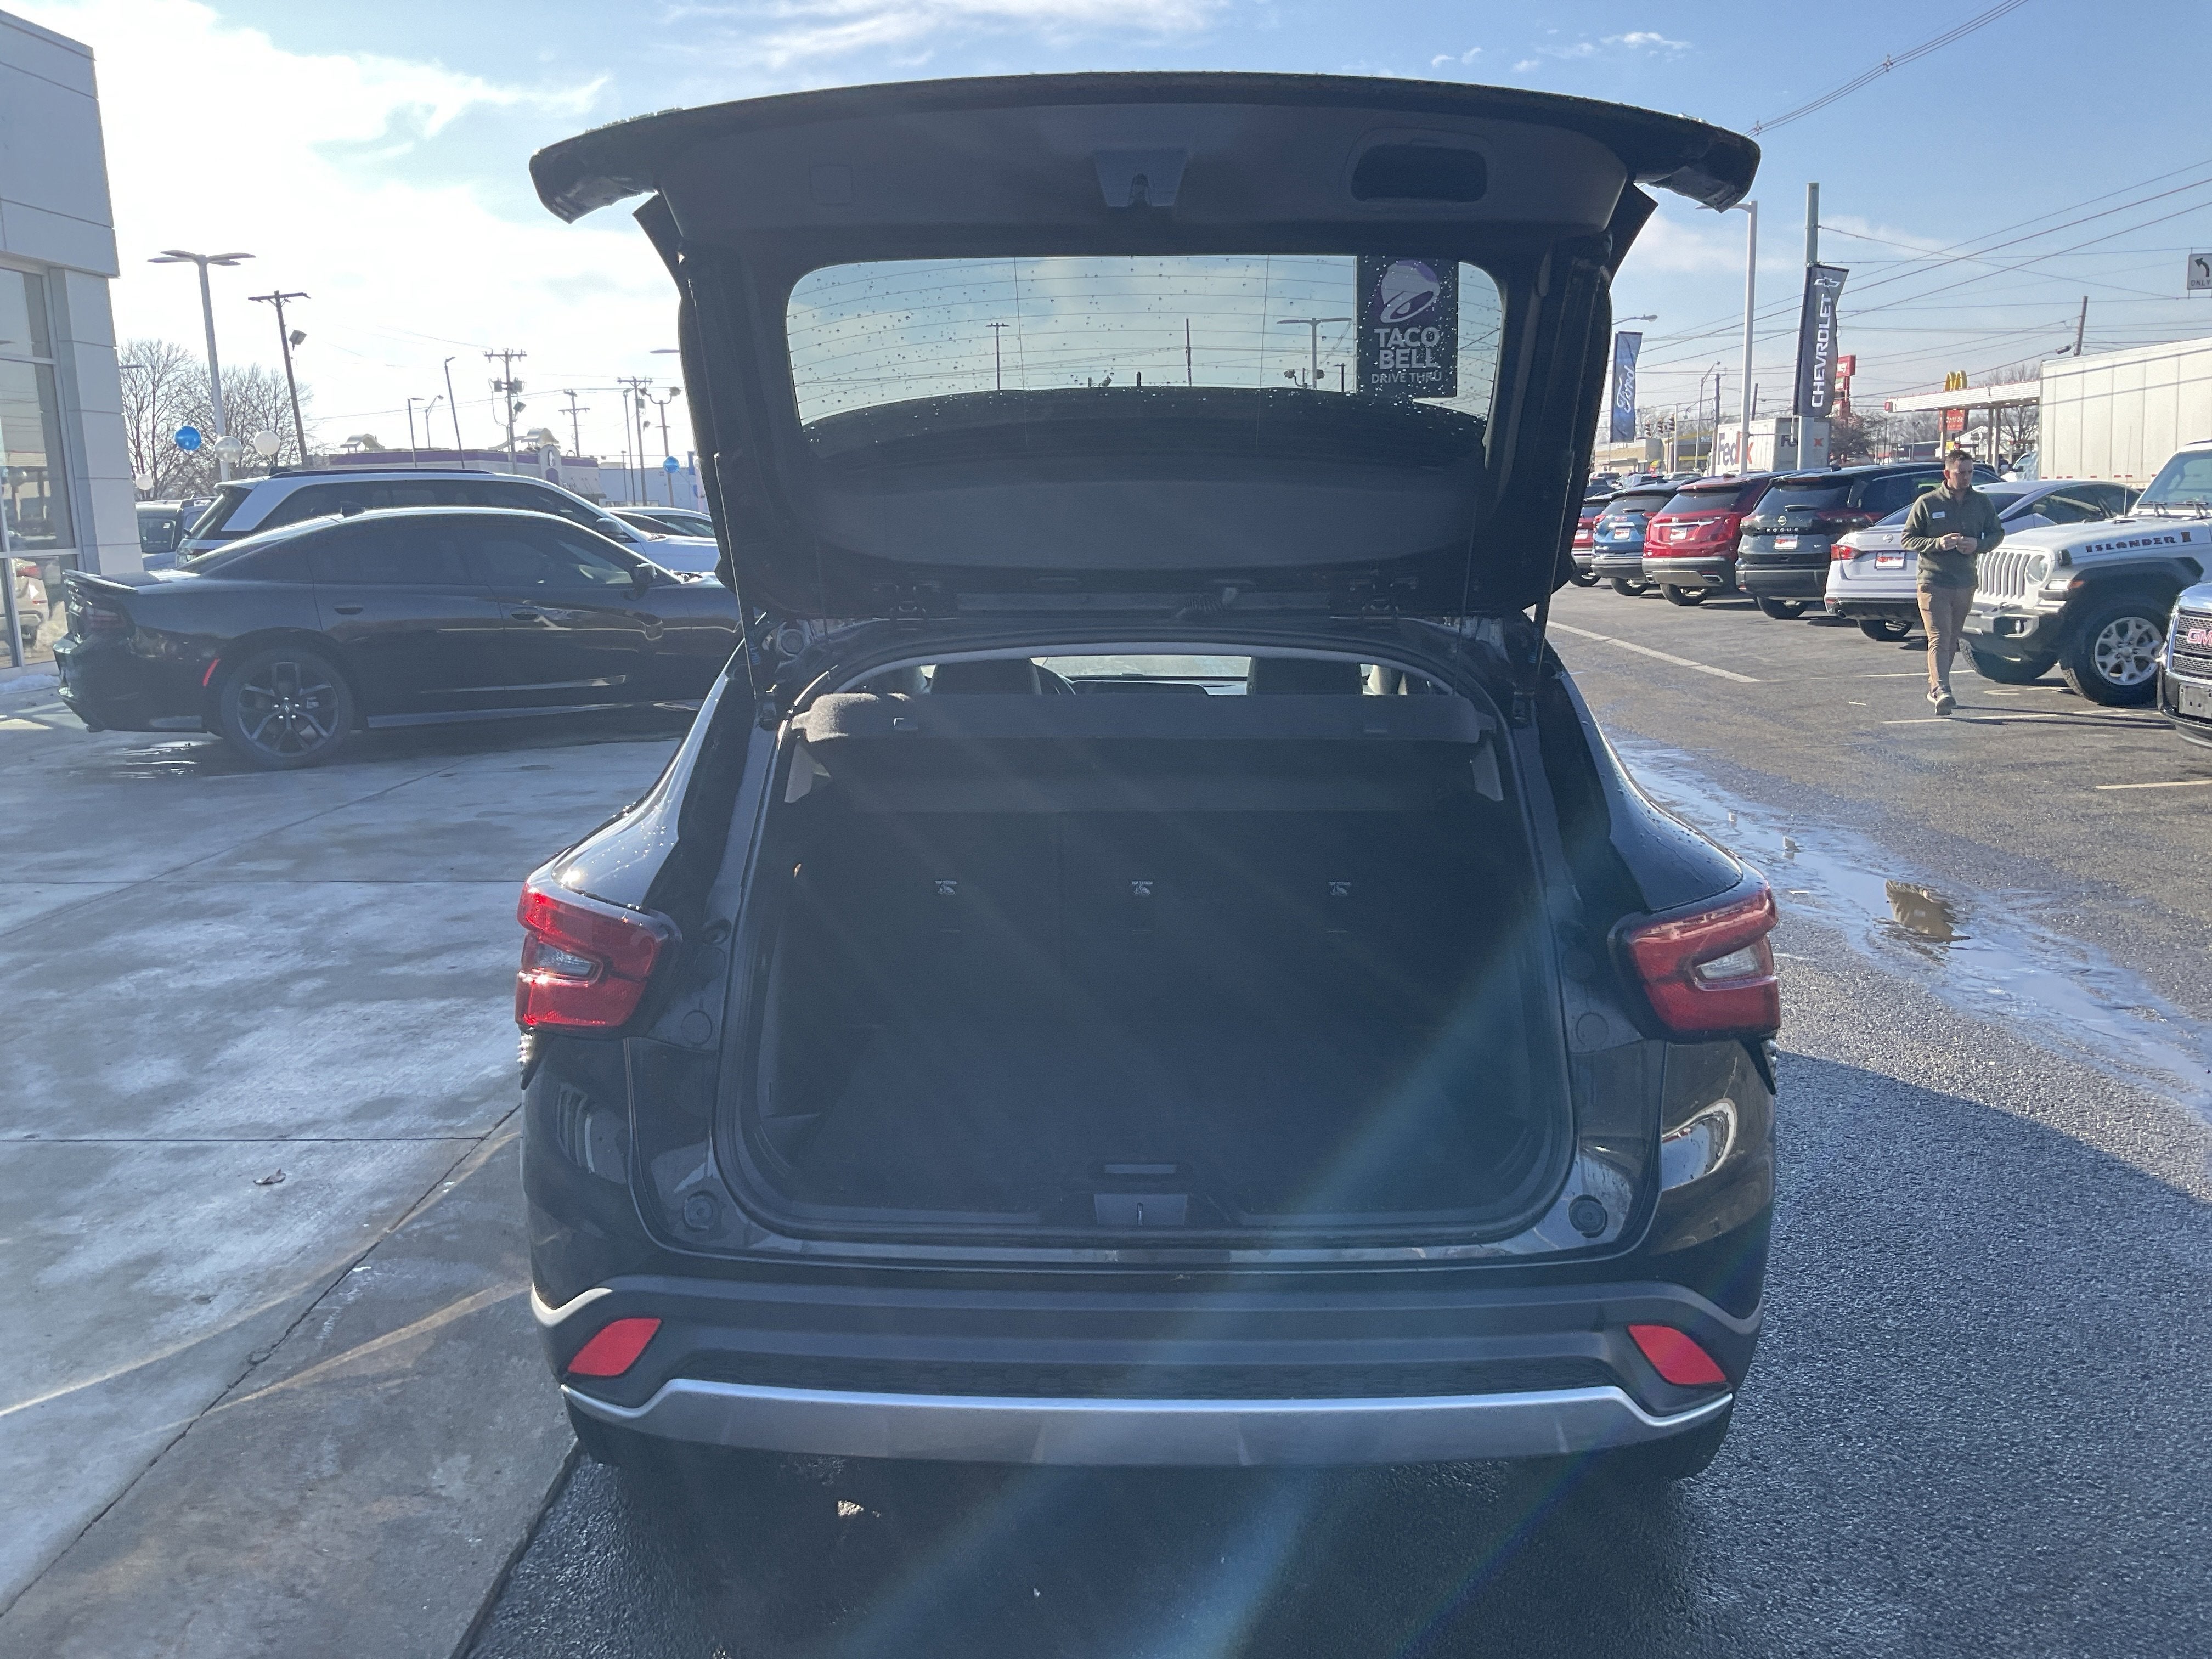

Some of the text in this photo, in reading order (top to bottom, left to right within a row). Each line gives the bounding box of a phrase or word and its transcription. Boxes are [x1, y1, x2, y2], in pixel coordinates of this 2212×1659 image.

[1374, 327, 1440, 348] TACO
[1379, 349, 1438, 369] BELL
[1811, 293, 1831, 408] CHEVROLET
[1372, 370, 1442, 384] DRIVE THRU
[1616, 365, 1635, 413] Ford
[1781, 435, 1823, 447] Fex
[2086, 535, 2177, 553] ISLANDER
